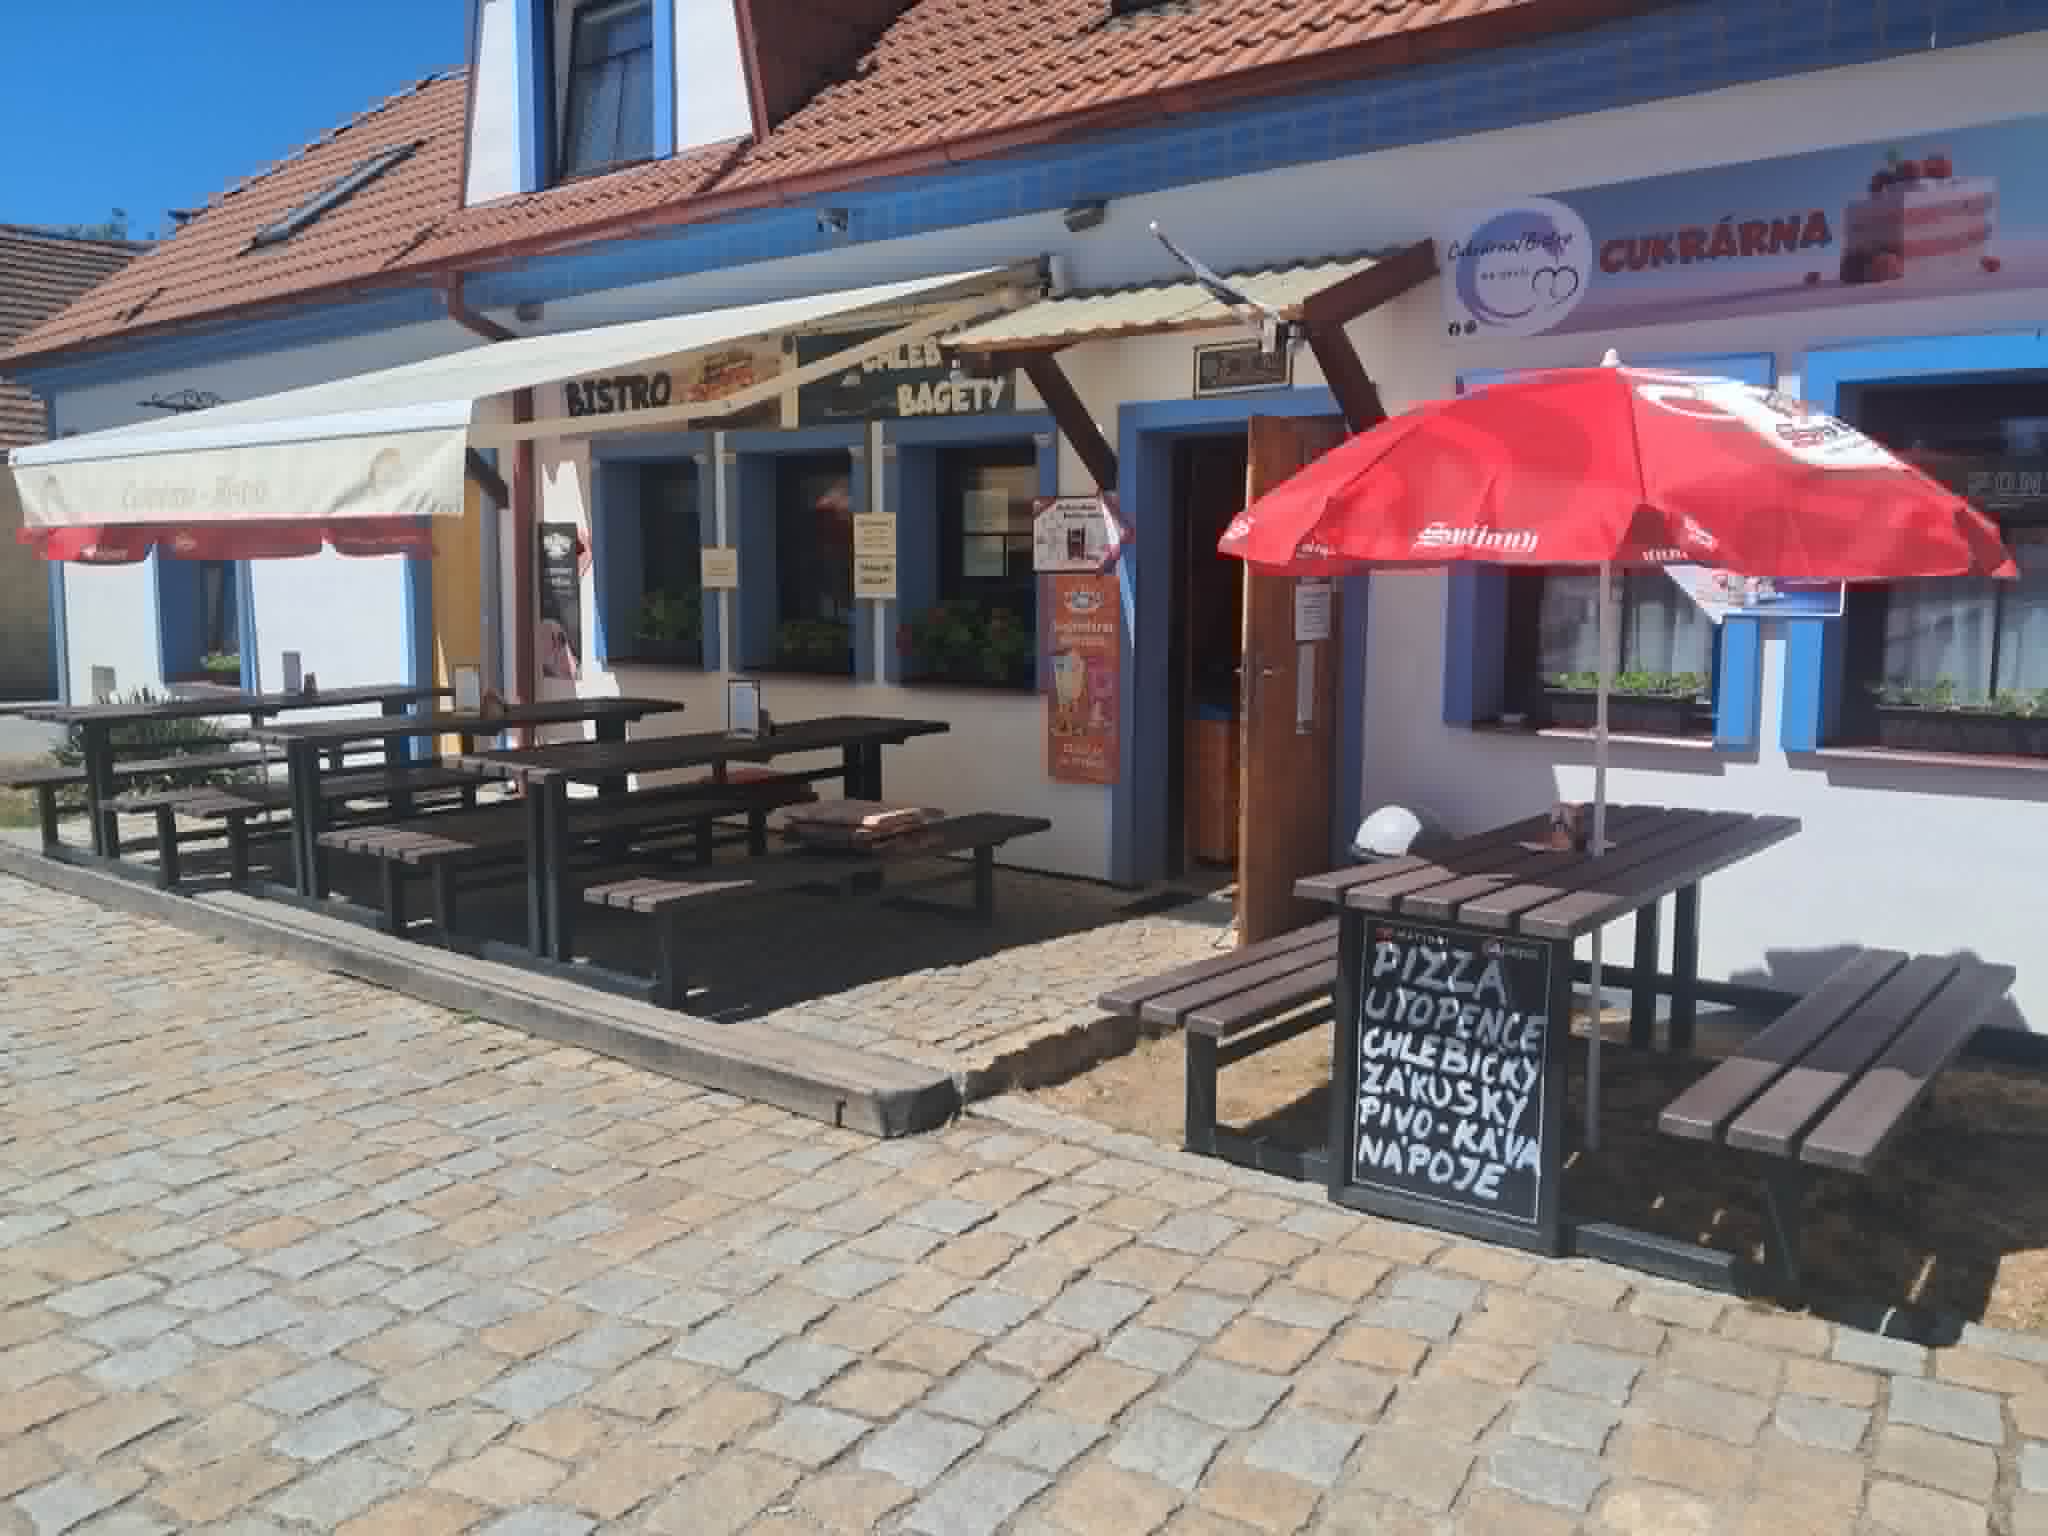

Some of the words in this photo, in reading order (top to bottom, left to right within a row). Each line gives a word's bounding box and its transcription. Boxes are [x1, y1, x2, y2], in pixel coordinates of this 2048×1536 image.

[1600, 207, 1832, 273] CUKRÁRNA
[565, 370, 671, 417] BISTRO
[896, 376, 1005, 417] BAGETY
[1372, 942, 1507, 1008] PIZZA
[1364, 986, 1548, 1052] UTOPENCE
